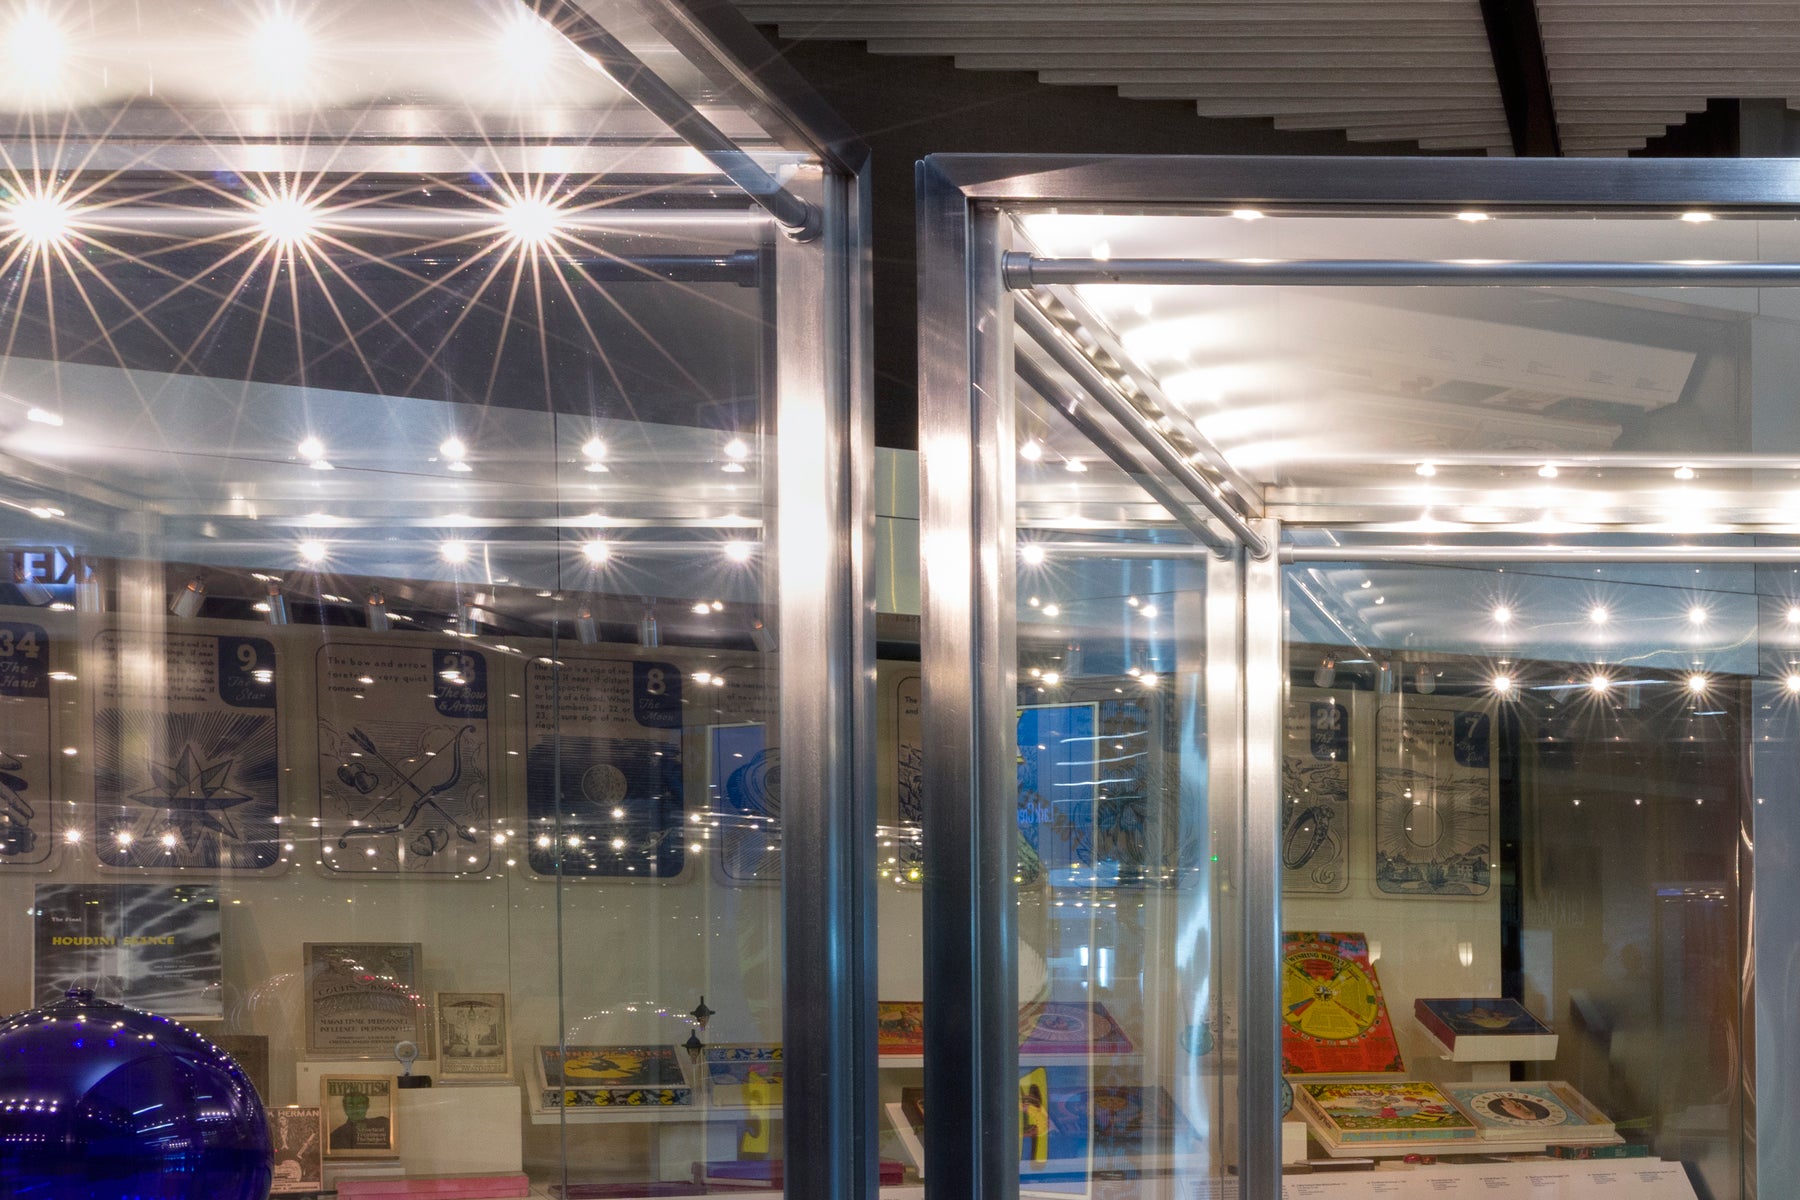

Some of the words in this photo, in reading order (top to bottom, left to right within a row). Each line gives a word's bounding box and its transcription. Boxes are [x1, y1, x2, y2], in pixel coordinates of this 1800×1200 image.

[237, 644, 258, 672] 9
[328, 657, 346, 665] The
[350, 657, 370, 666] bow
[375, 660, 393, 668] and
[647, 668, 667, 696] 8
[438, 687, 458, 698] The
[439, 702, 449, 711] &
[450, 701, 486, 712] Arrow
[1465, 717, 1478, 738] 7
[52, 936, 115, 946] HOUDINI
[329, 1080, 389, 1096] HYPNOTISM
